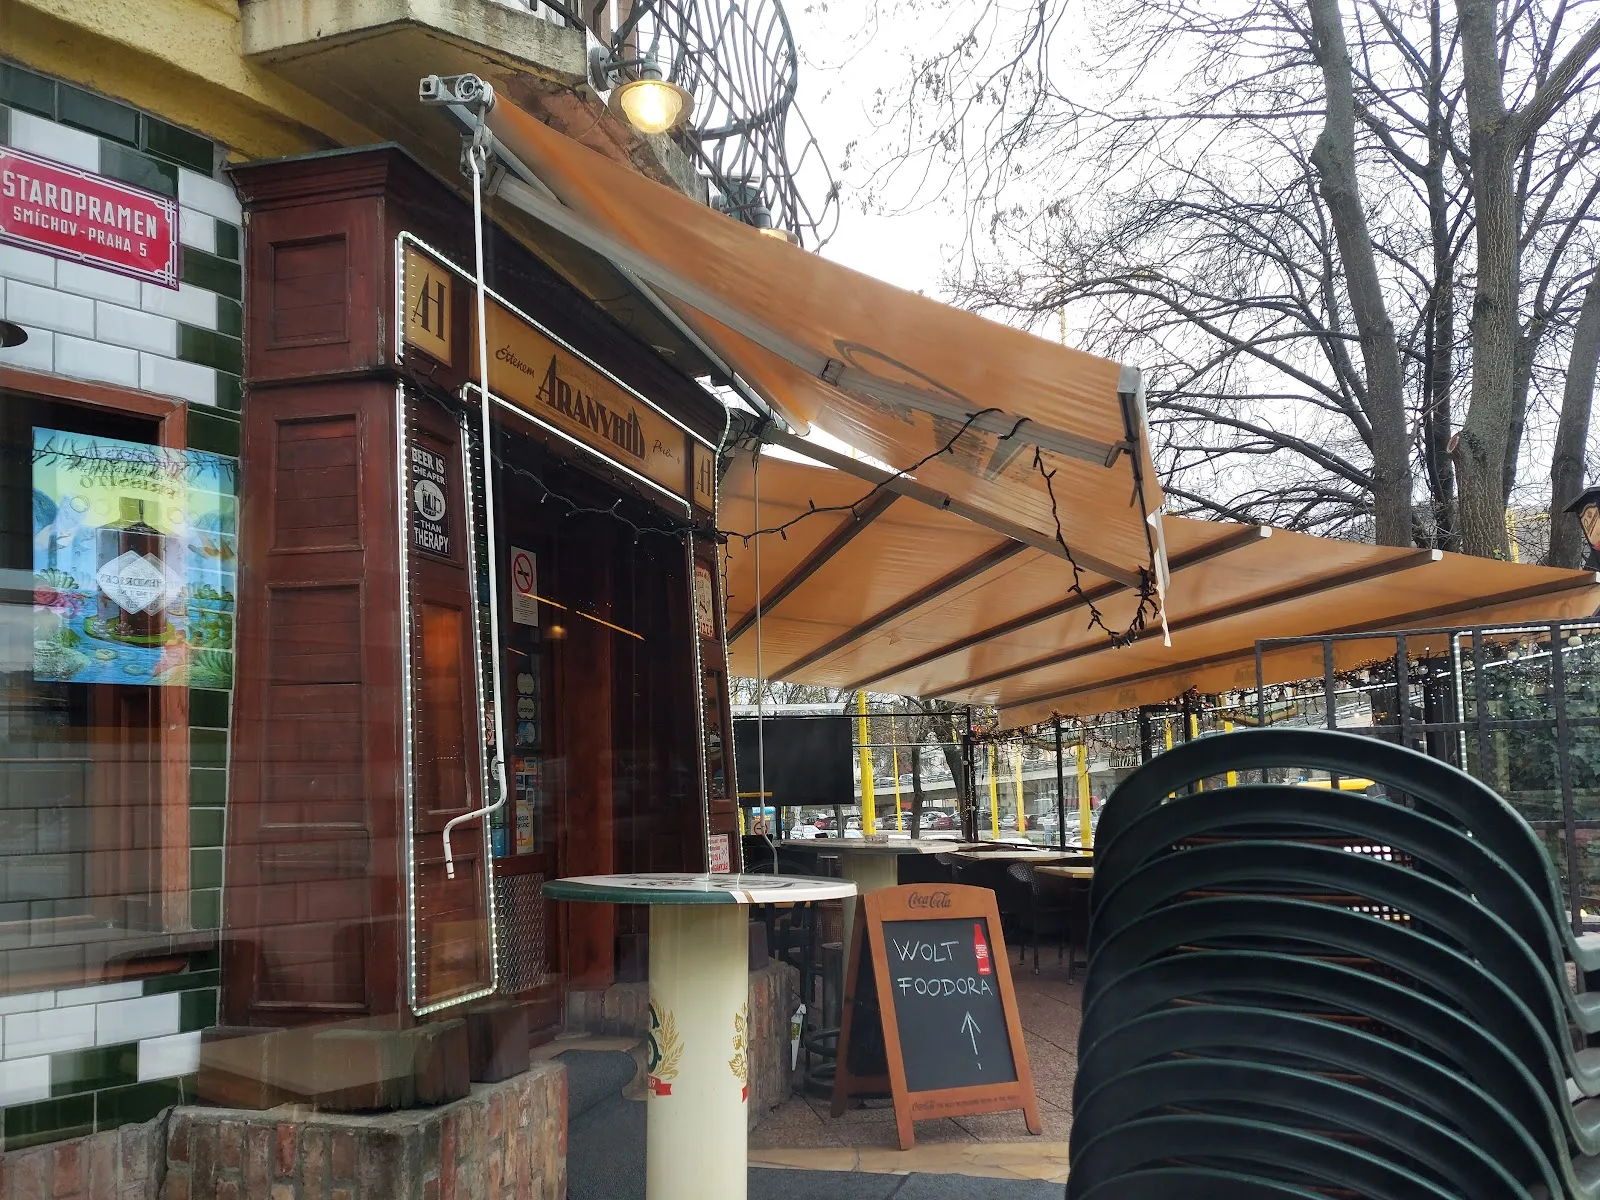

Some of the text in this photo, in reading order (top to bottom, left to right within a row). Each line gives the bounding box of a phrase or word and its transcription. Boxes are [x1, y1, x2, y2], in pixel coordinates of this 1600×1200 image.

[2, 170, 157, 240] STAROPRAMEN
[139, 242, 148, 257] 5
[411, 447, 445, 475] BEER IS
[412, 464, 446, 485] CHEAPER
[420, 519, 442, 534] THAN
[413, 526, 449, 553] THERAPY
[892, 938, 960, 963] WOLT
[897, 977, 993, 996] FOODORA
